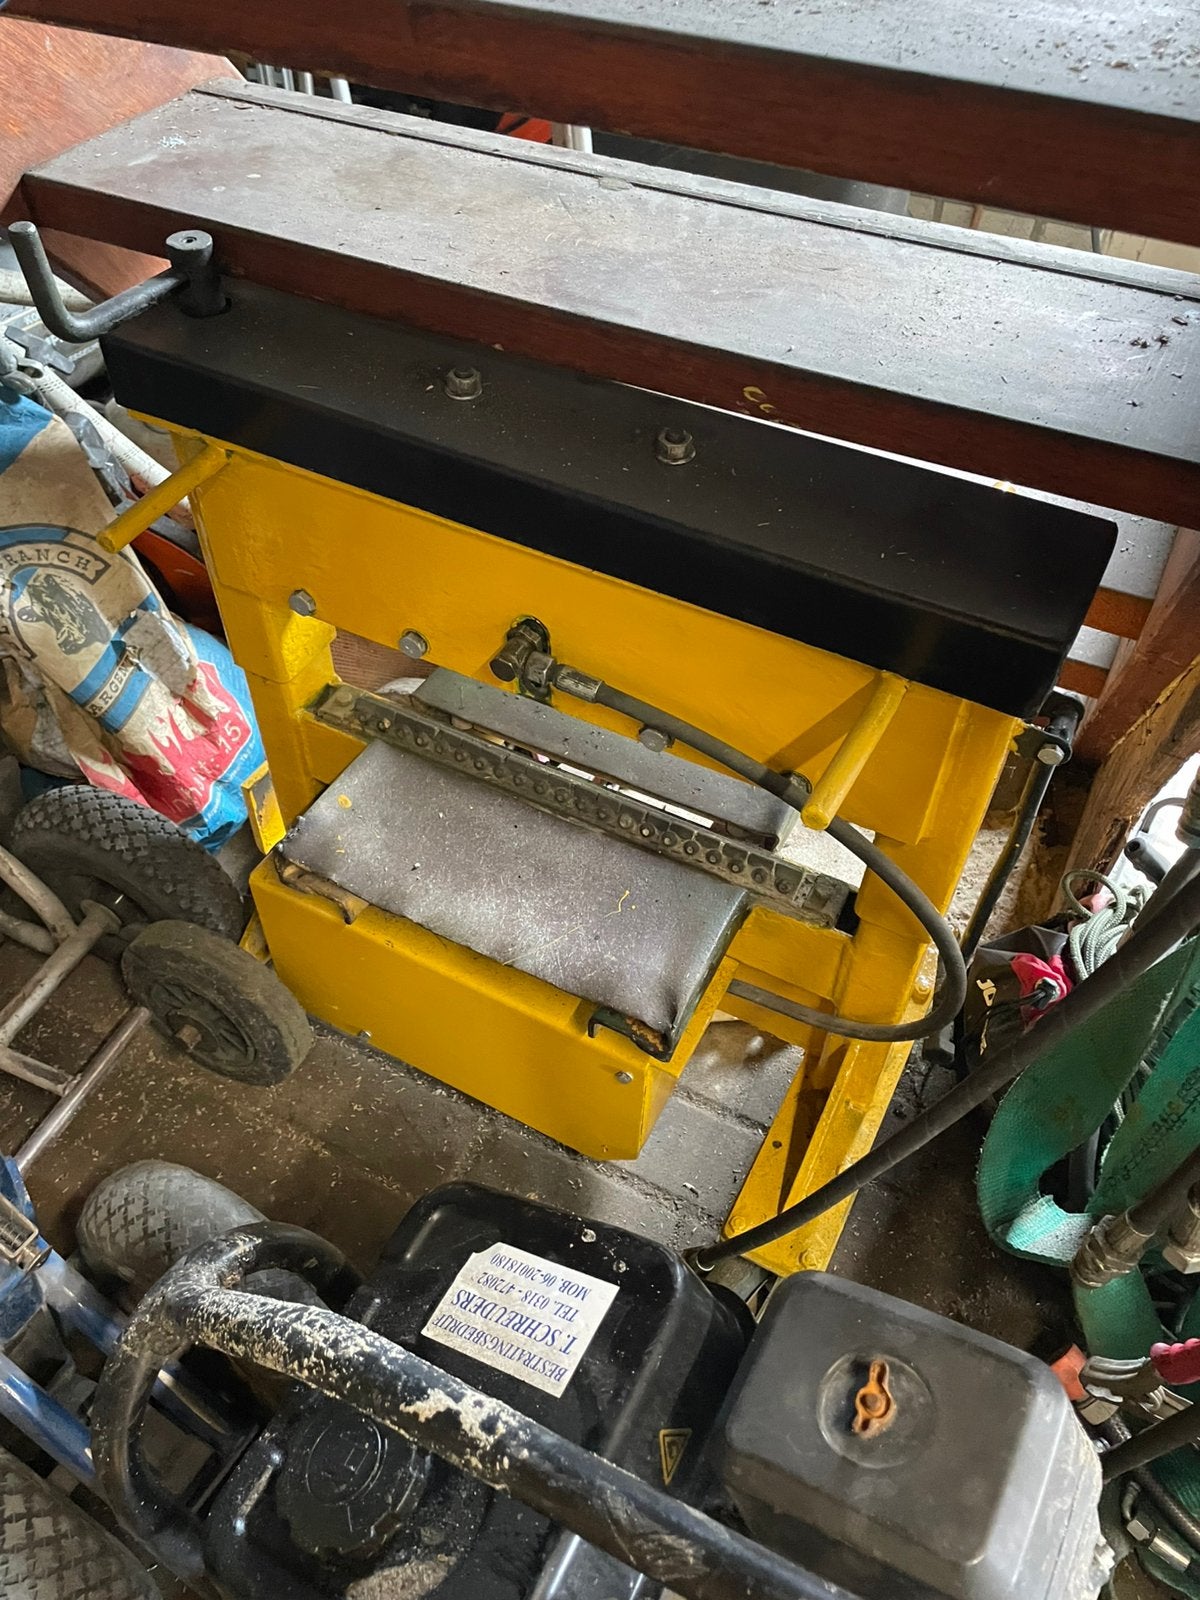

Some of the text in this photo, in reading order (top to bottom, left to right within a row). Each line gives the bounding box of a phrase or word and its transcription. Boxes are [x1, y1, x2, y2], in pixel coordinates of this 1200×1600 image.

[4, 548, 90, 572] RANCH
[477, 1271, 515, 1295] 472082
[490, 1253, 592, 1301] MOB. 06-20018180
[521, 1289, 550, 1310] 0318
[553, 1301, 580, 1322] TEL.
[451, 1288, 578, 1355] T. SCHREUDERS
[432, 1313, 568, 1382] BESTRATINGSBEDRIJF
